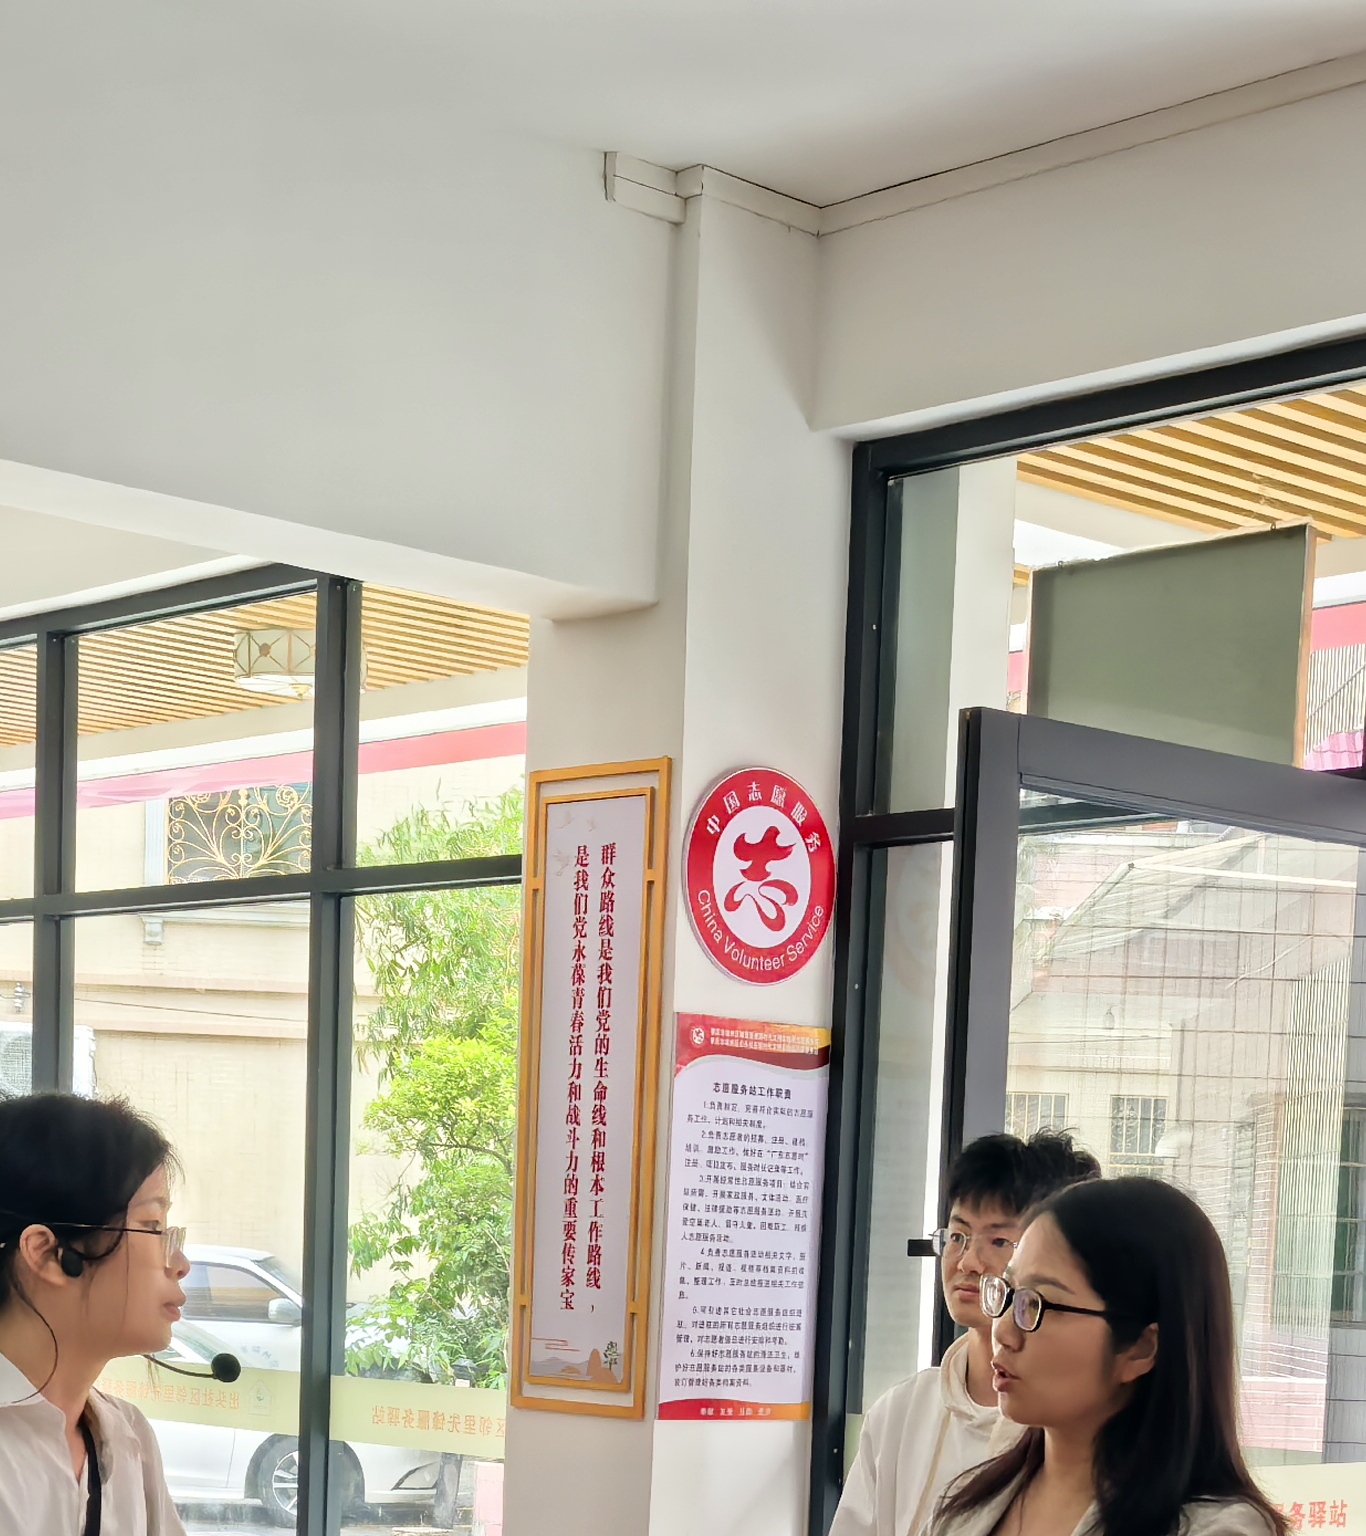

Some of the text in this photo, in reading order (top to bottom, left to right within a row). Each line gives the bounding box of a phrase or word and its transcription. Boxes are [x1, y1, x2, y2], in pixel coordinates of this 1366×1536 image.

[706, 780, 822, 853] 中国志愿服务
[696, 888, 825, 972] China Volunteer Service
[559, 844, 590, 1310] 是我们党永葆青春活力和战斗力的重要传家宝
[712, 1081, 792, 1100] 志愿服务站工作职责
